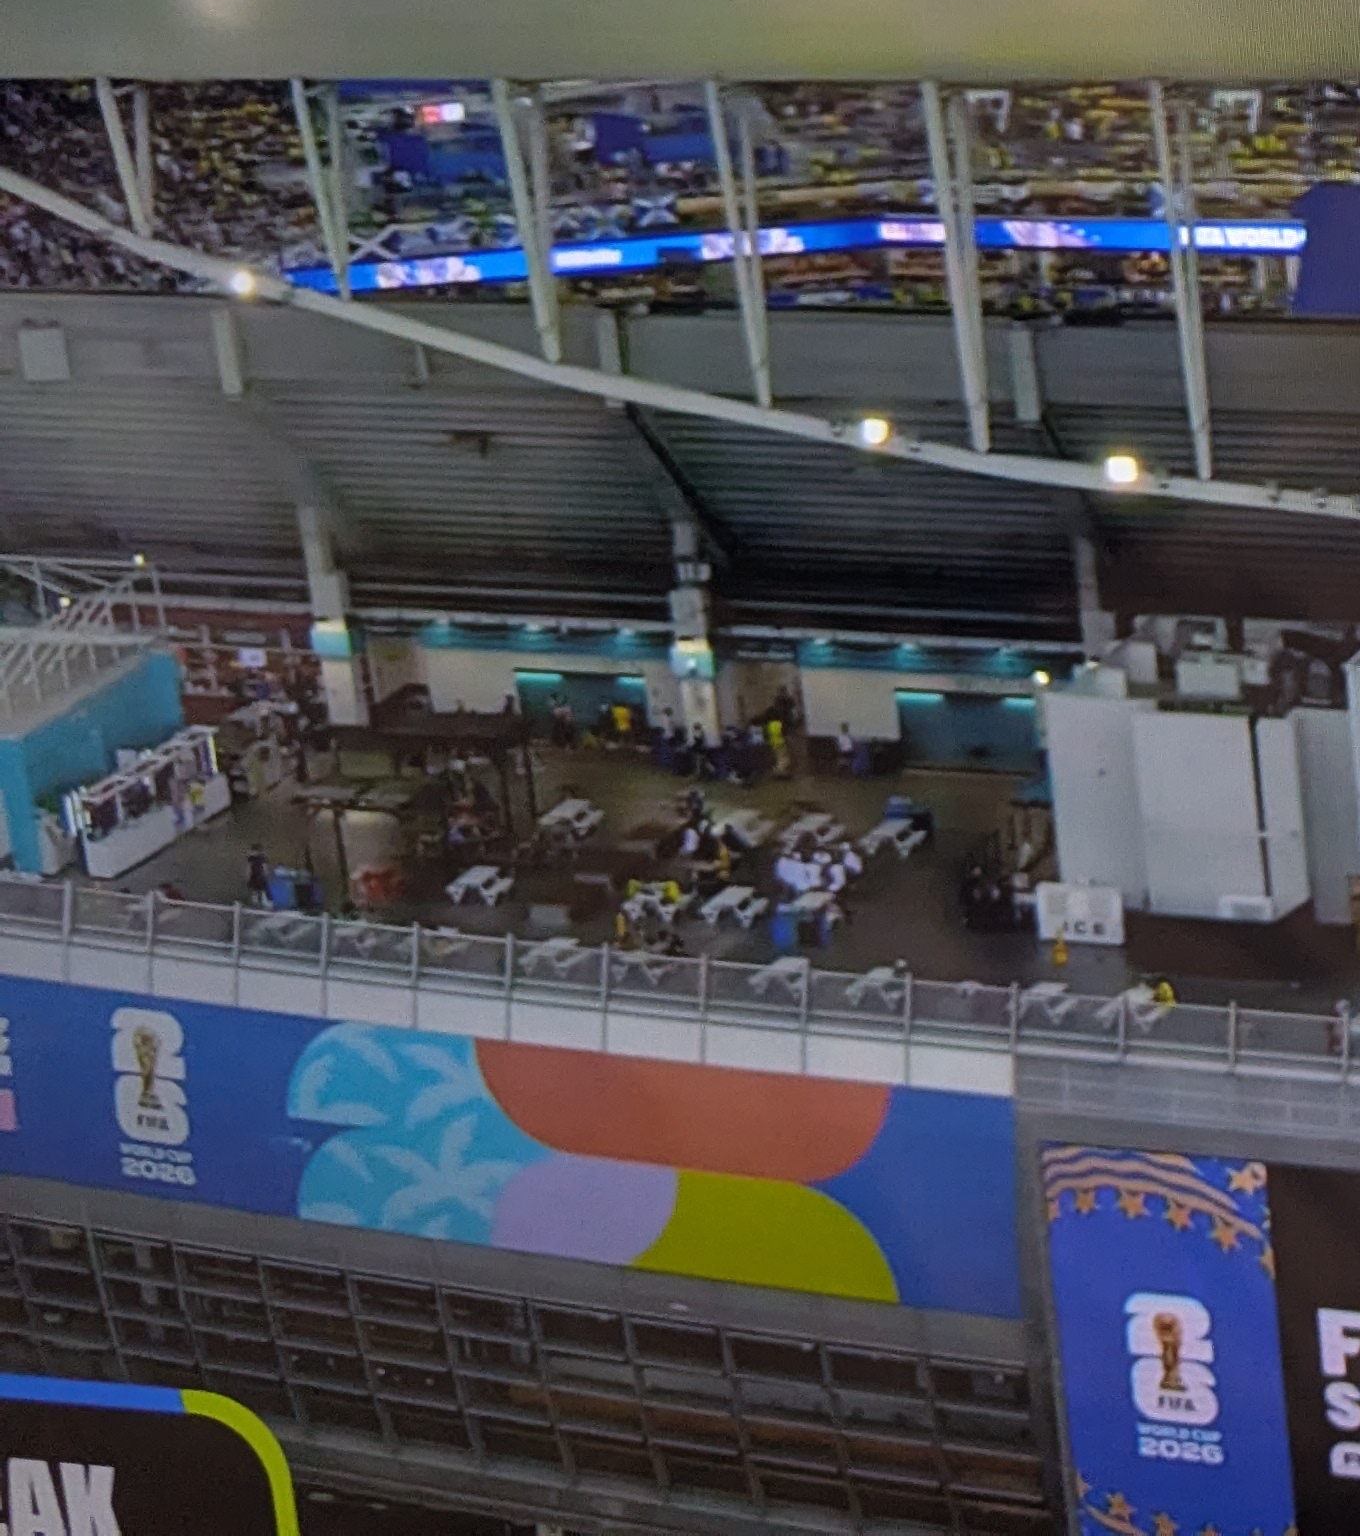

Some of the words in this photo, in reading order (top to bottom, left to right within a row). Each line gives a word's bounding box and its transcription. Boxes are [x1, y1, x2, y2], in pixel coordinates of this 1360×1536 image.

[120, 1157, 197, 1185] 2026
[1138, 1436, 1225, 1465] 2026
[0, 1456, 122, 1536] AK
